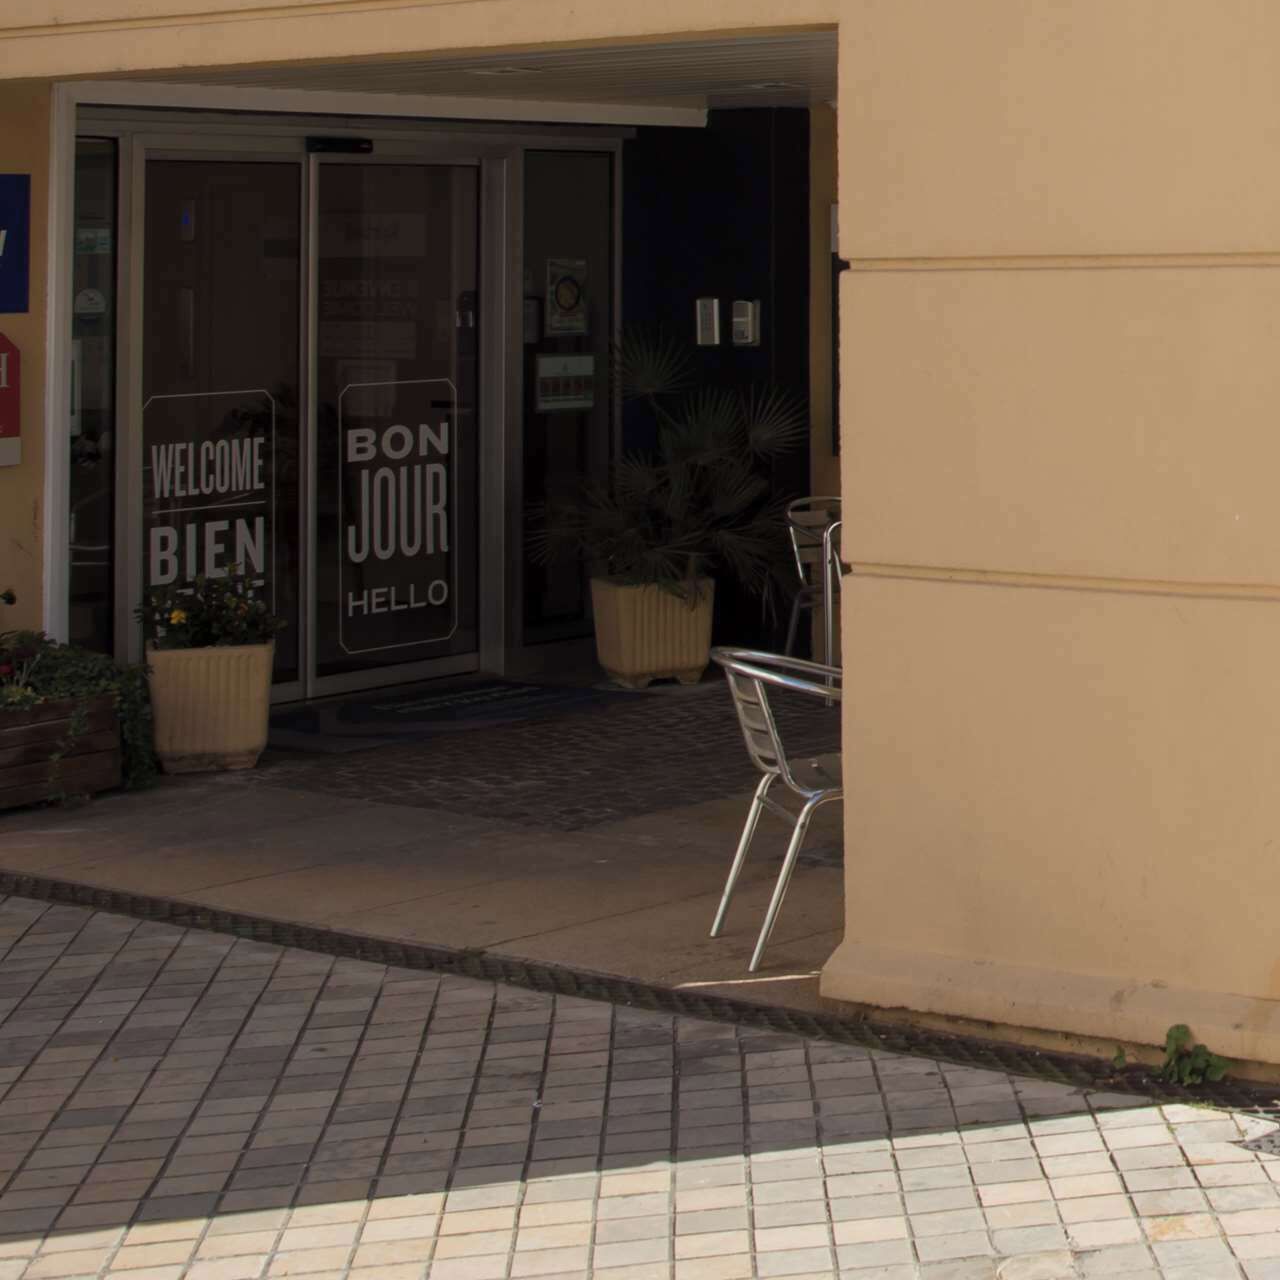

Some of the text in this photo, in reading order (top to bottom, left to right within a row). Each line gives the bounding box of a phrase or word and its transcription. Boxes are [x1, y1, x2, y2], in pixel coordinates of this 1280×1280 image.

[151, 437, 265, 498] WELCOME
[347, 422, 449, 463] BON
[347, 463, 449, 563] JOUR
[150, 516, 265, 586] BIEN
[347, 579, 449, 617] HELLO
